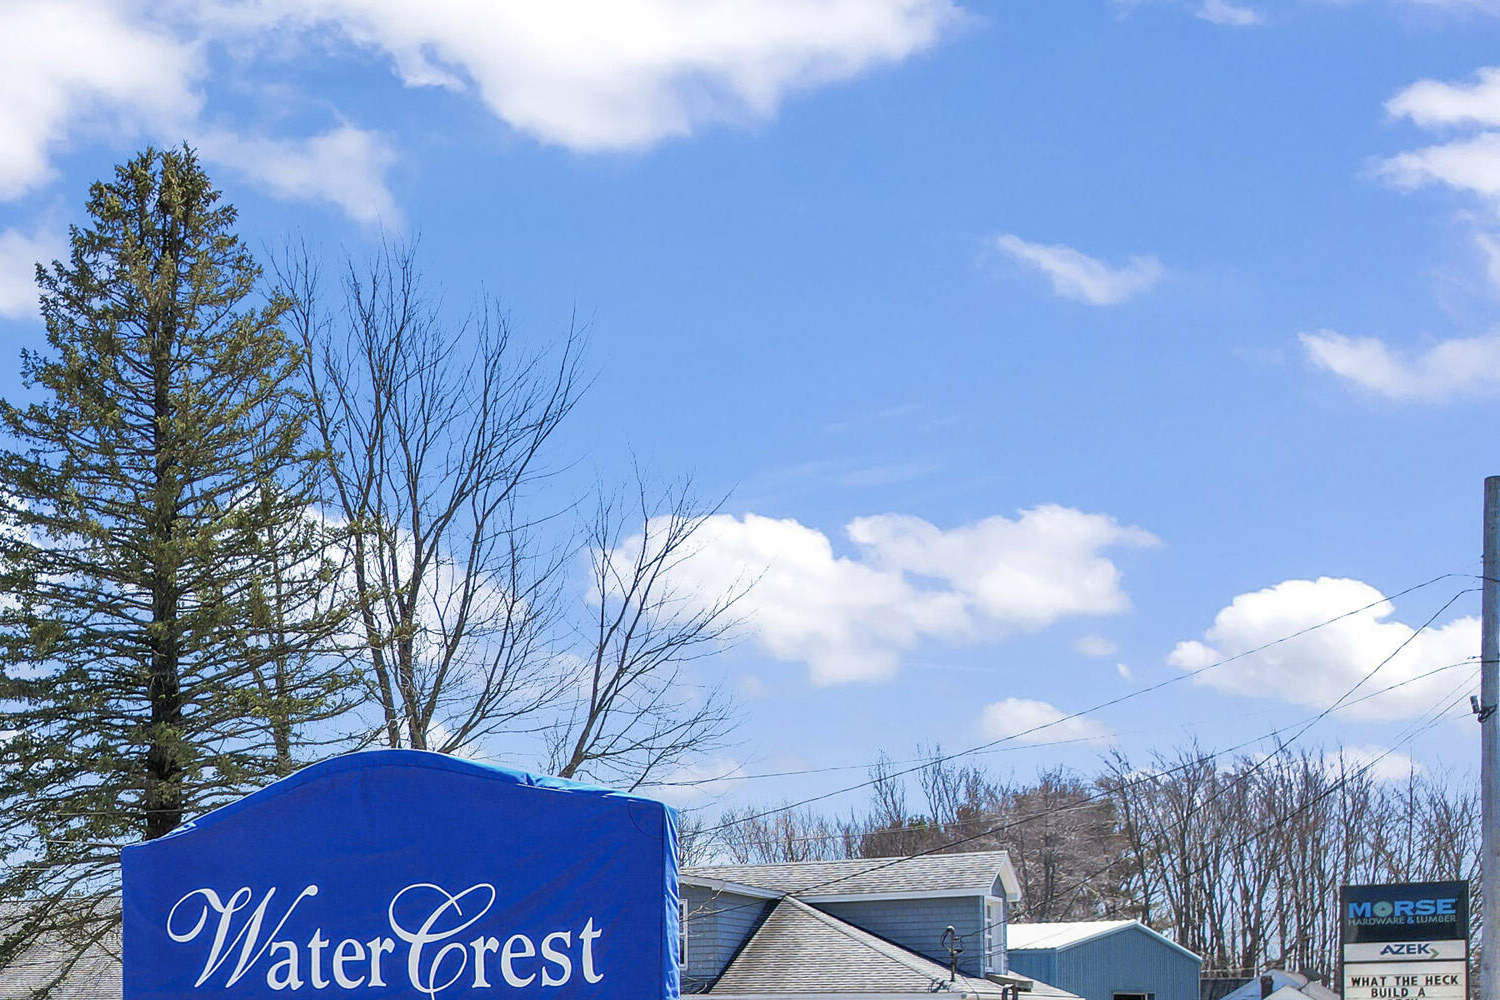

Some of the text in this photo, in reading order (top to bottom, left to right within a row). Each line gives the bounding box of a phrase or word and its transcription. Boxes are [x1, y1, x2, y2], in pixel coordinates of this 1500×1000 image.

[1348, 899, 1456, 917] MORSE
[1348, 916, 1405, 926] HARDWARE
[1416, 915, 1456, 923] LUMBER
[1380, 944, 1430, 955] AZEK
[1351, 975, 1459, 987] WHAT THE HECK
[1371, 988, 1426, 998] BUILD A
